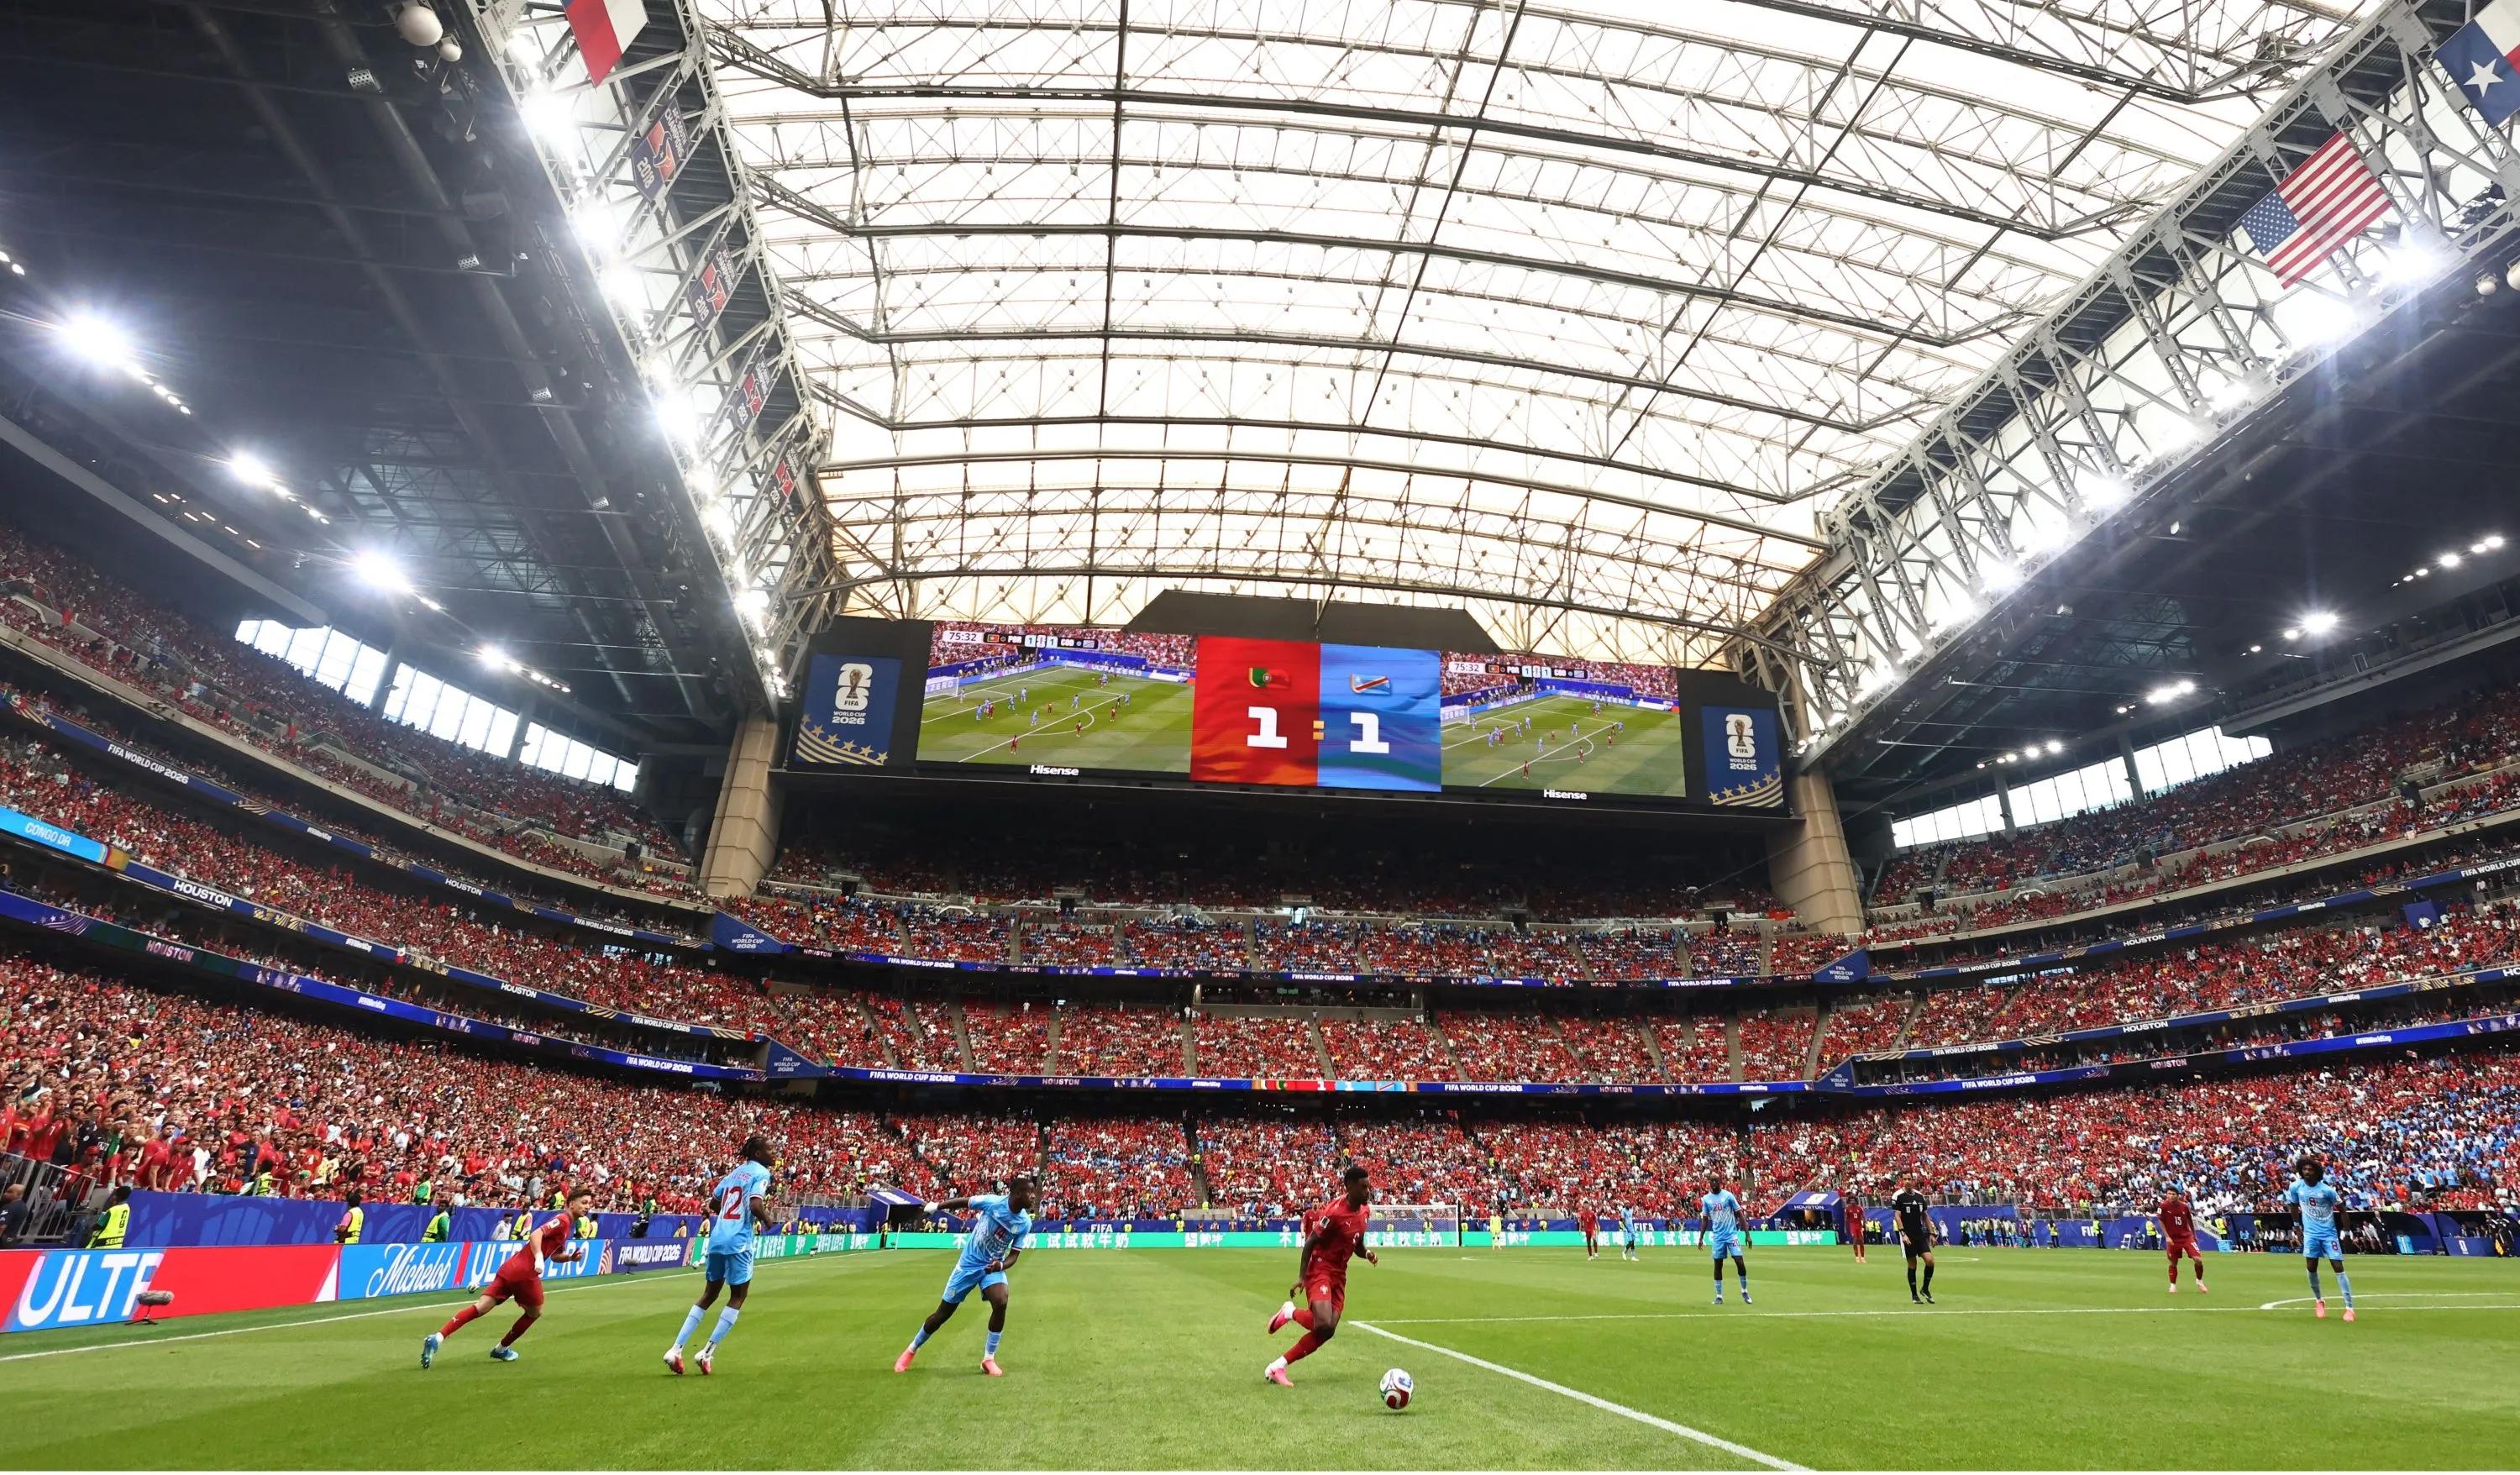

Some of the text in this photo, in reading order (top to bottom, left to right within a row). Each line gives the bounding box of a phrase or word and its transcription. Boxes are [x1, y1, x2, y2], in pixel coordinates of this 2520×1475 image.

[637, 156, 654, 188] 2018
[695, 296, 709, 321] 2019
[949, 632, 977, 642] 75:32
[1008, 635, 1021, 643] POR
[1116, 667, 1142, 676] ZERO
[1454, 663, 1479, 671] 75:32
[933, 681, 953, 690] ZERO
[1247, 706, 1287, 748] 1
[1350, 712, 1389, 753] 1
[108, 744, 189, 785] FIFA WORLD CUP 2026
[1030, 764, 1079, 775] Hisense
[1543, 789, 1587, 800] Hisense
[26, 822, 71, 847] CONGO DR
[2460, 858, 2520, 877] FIFA WORLD CUP
[173, 880, 234, 907] HOUSTON
[445, 878, 483, 896] HOUSTON
[585, 920, 603, 929] WORLD
[613, 927, 633, 937] 2026
[2123, 933, 2166, 947] HOUSTON
[146, 940, 194, 962] HOUSTON
[803, 948, 832, 958] HOUSTON
[501, 982, 538, 998] HOUSTON
[643, 1019, 663, 1027] WORLD
[672, 1024, 690, 1032] 2026
[2123, 1021, 2169, 1033] HOUSTON
[512, 1032, 541, 1045] HOUSTON
[626, 1057, 693, 1073] FIFA WORLD CUP 2026
[2150, 1058, 2187, 1069] HOUSTON
[887, 1072, 913, 1080] WORLD
[1977, 1079, 2002, 1088] WORLD
[2002, 1078, 2014, 1086] CUP
[2014, 1075, 2036, 1084] 2026
[1317, 1080, 1326, 1090] 1
[722, 1186, 743, 1220] 12
[1714, 1202, 1723, 1210] 20
[2309, 1197, 2317, 1206] 8
[1634, 1223, 1655, 1231] FIFA
[2175, 1216, 2182, 1226] 15
[1090, 1224, 1114, 1233] FIFA
[2332, 1241, 2339, 1251] 8
[365, 1242, 457, 1298] Michelob
